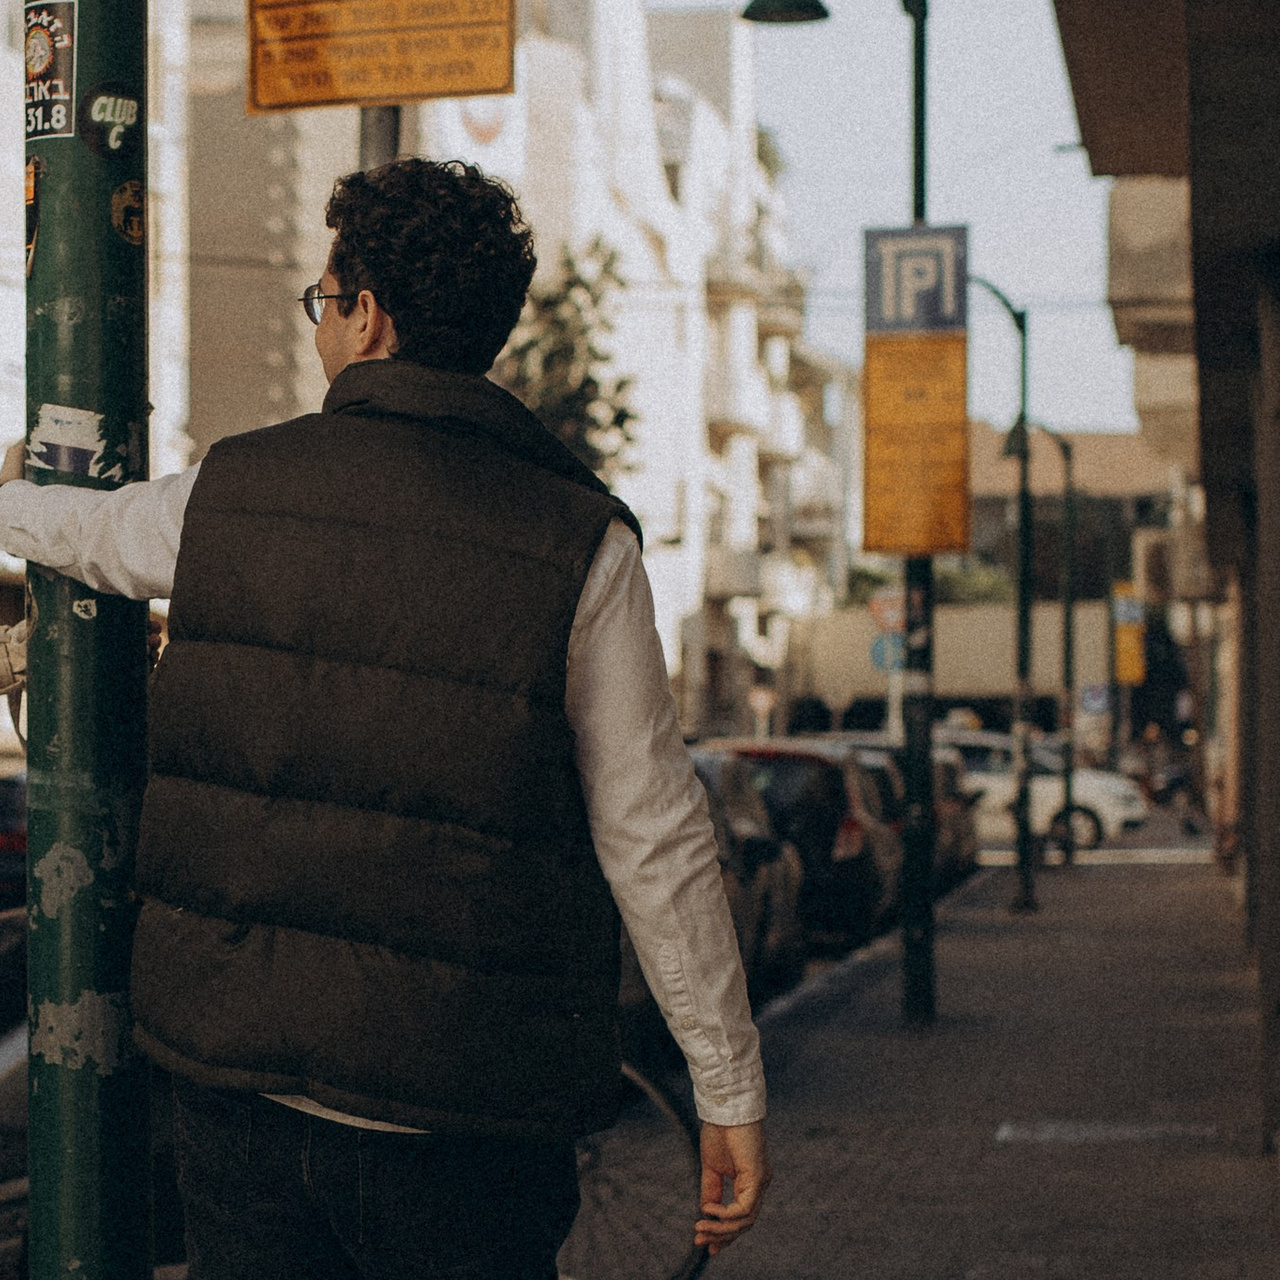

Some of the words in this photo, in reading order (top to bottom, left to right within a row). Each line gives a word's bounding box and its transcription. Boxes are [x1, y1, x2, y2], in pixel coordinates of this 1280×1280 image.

[25, 9, 72, 48] הזאב
[26, 104, 67, 132] 31.8
[91, 95, 138, 125] CLUB
[109, 124, 125, 149] C
